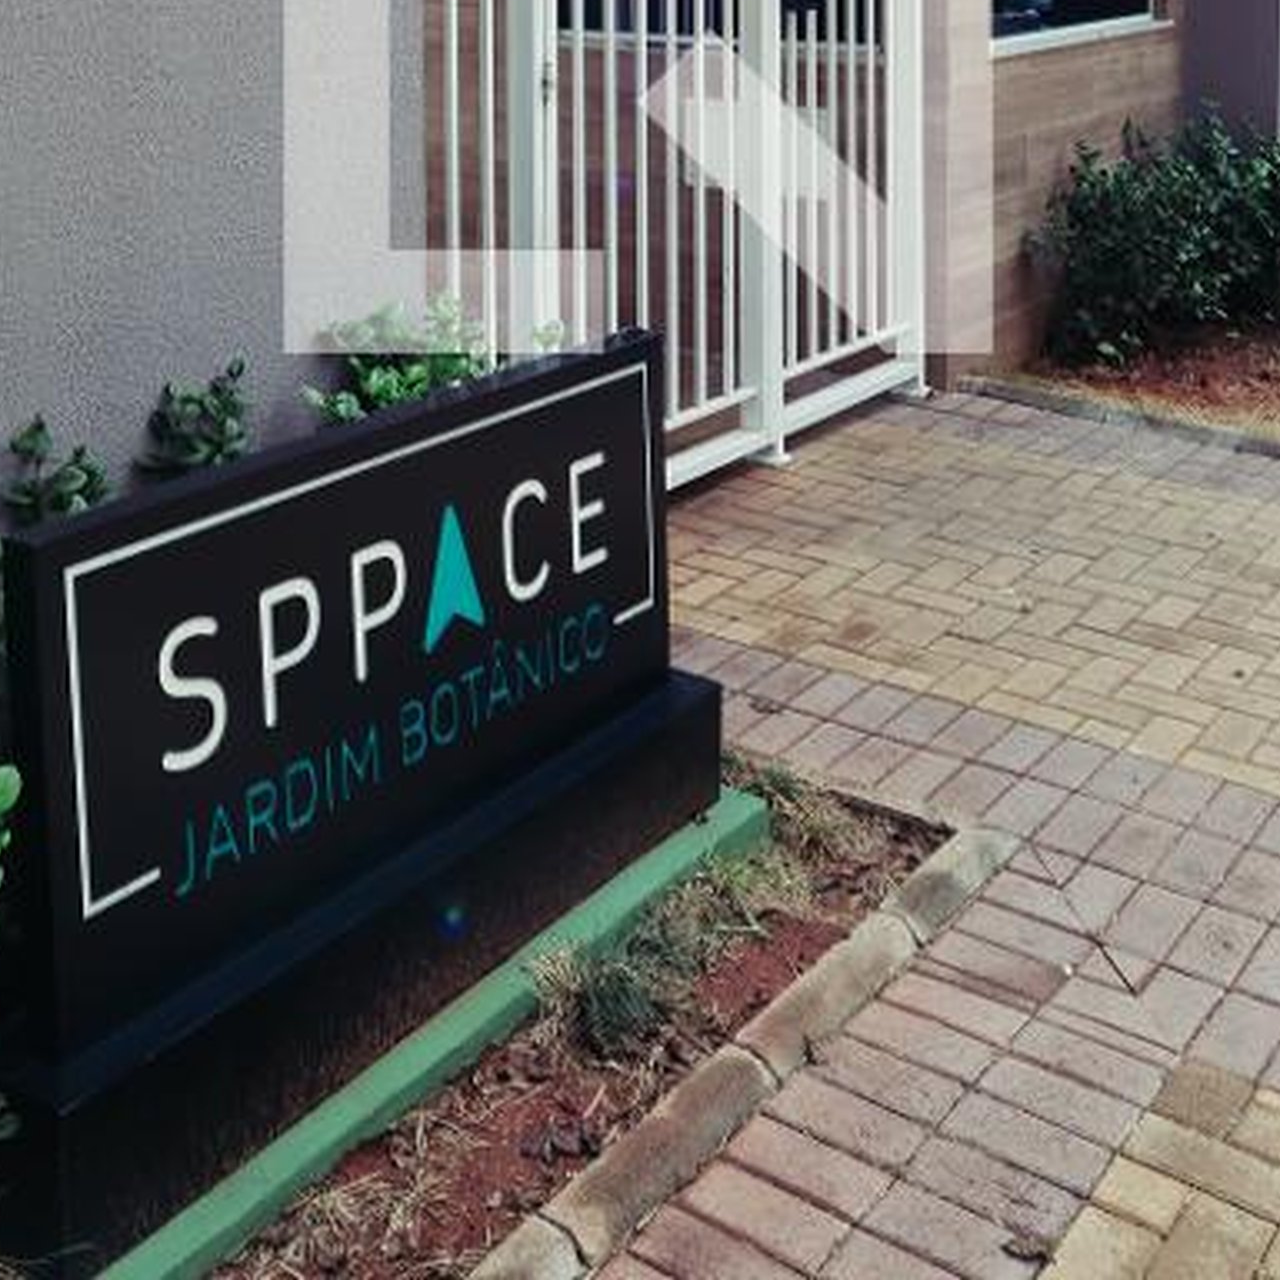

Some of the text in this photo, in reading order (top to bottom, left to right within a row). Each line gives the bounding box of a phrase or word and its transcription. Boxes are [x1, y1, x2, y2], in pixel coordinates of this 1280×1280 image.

[158, 451, 609, 771] SPPACE
[174, 602, 610, 897] JARDIM BOTÂNICO
